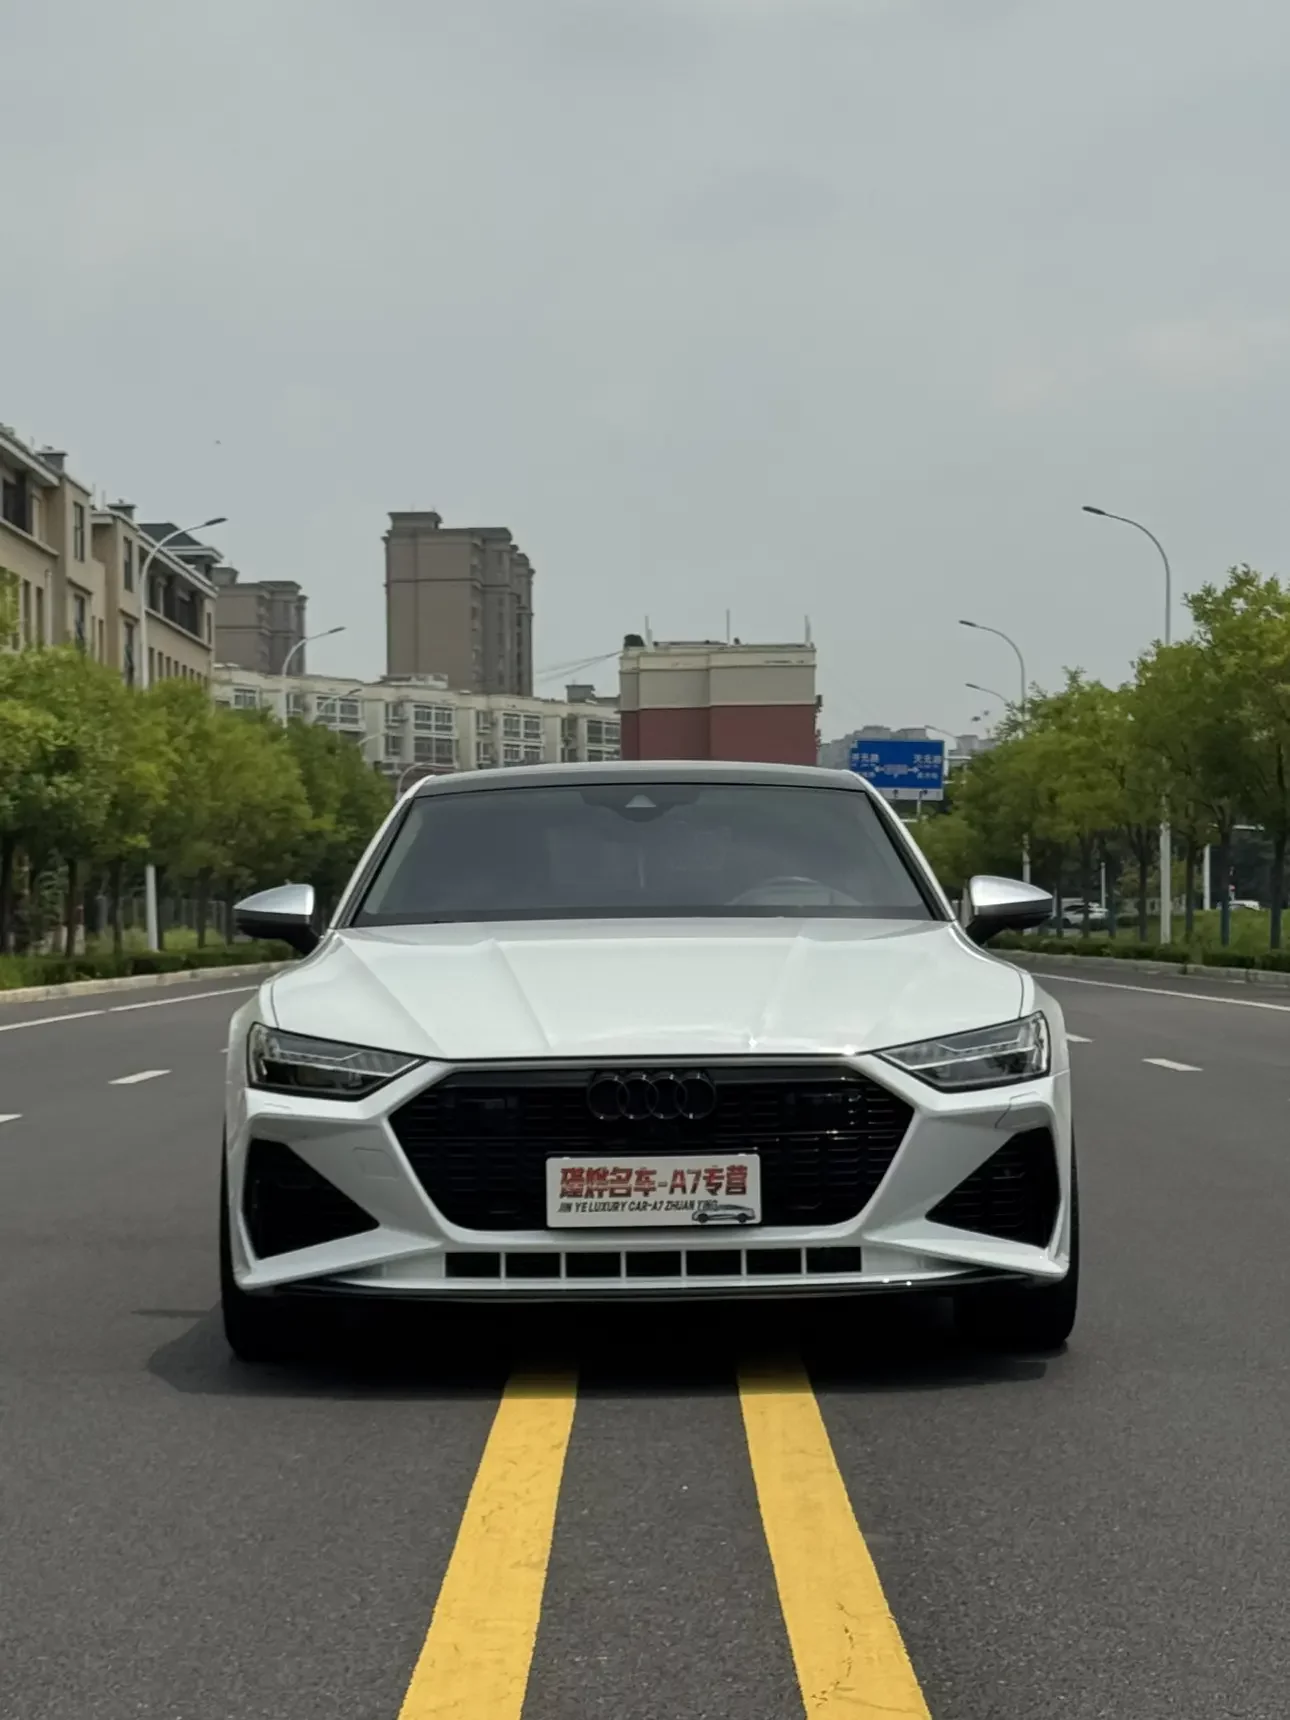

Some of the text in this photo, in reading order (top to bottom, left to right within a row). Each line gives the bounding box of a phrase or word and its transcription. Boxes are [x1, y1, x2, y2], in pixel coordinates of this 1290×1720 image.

[575, 1201, 588, 1212] YE
[588, 1201, 630, 1212] LUXURY
[664, 1200, 695, 1211] ZHUAN
